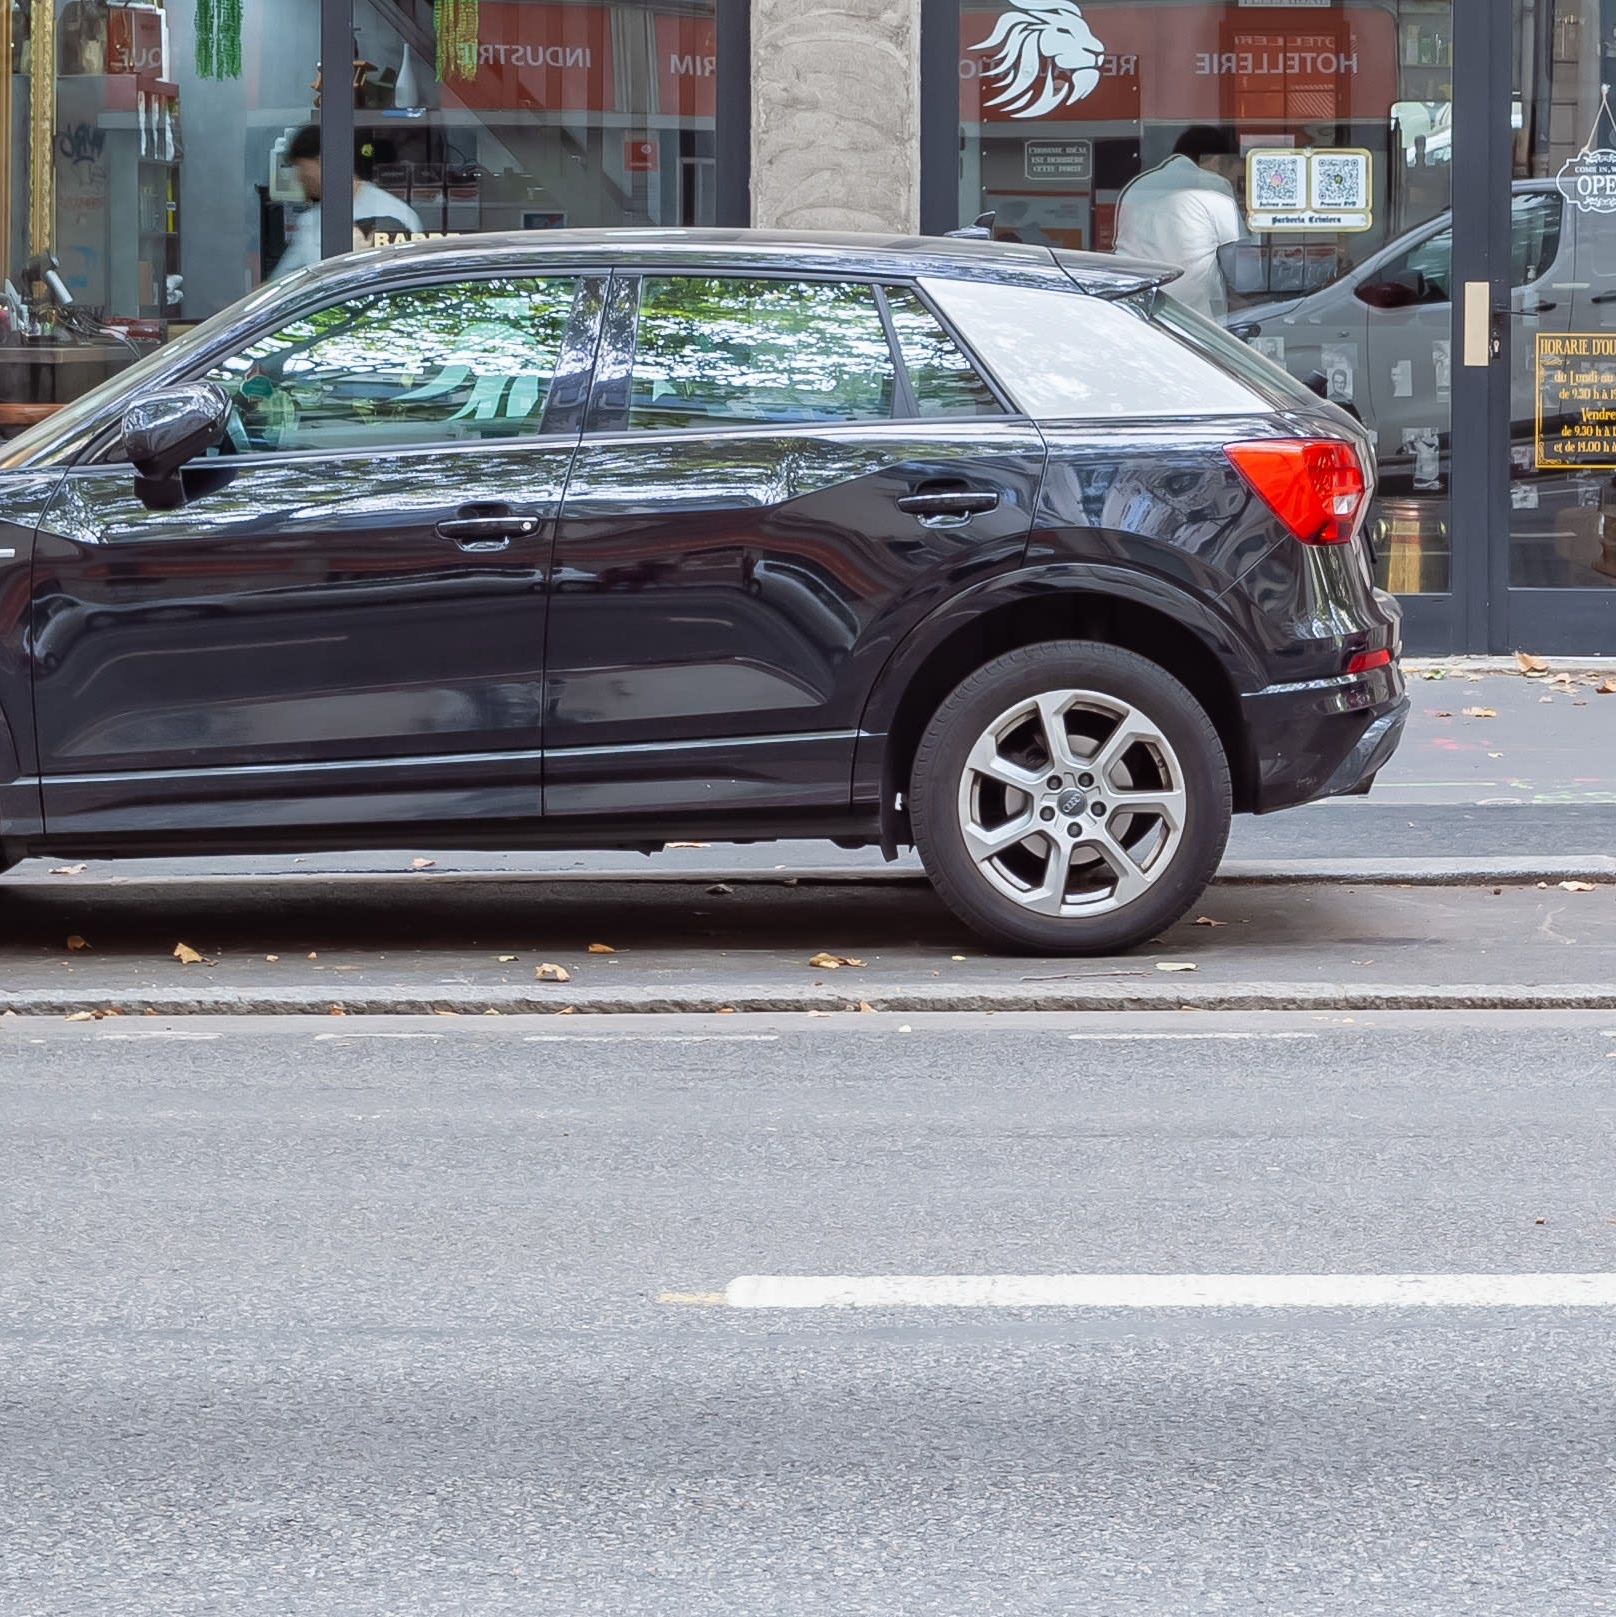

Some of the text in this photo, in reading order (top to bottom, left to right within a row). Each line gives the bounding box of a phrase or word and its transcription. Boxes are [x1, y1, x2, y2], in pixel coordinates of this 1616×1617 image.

[1570, 370, 1598, 386] Lundi
[1559, 388, 1569, 400] de
[1593, 388, 1600, 400] h
[1561, 425, 1572, 436] de
[1574, 425, 1593, 436] 9.30
[1595, 425, 1602, 436] h
[1565, 441, 1576, 453] de
[1603, 441, 1610, 453] h
